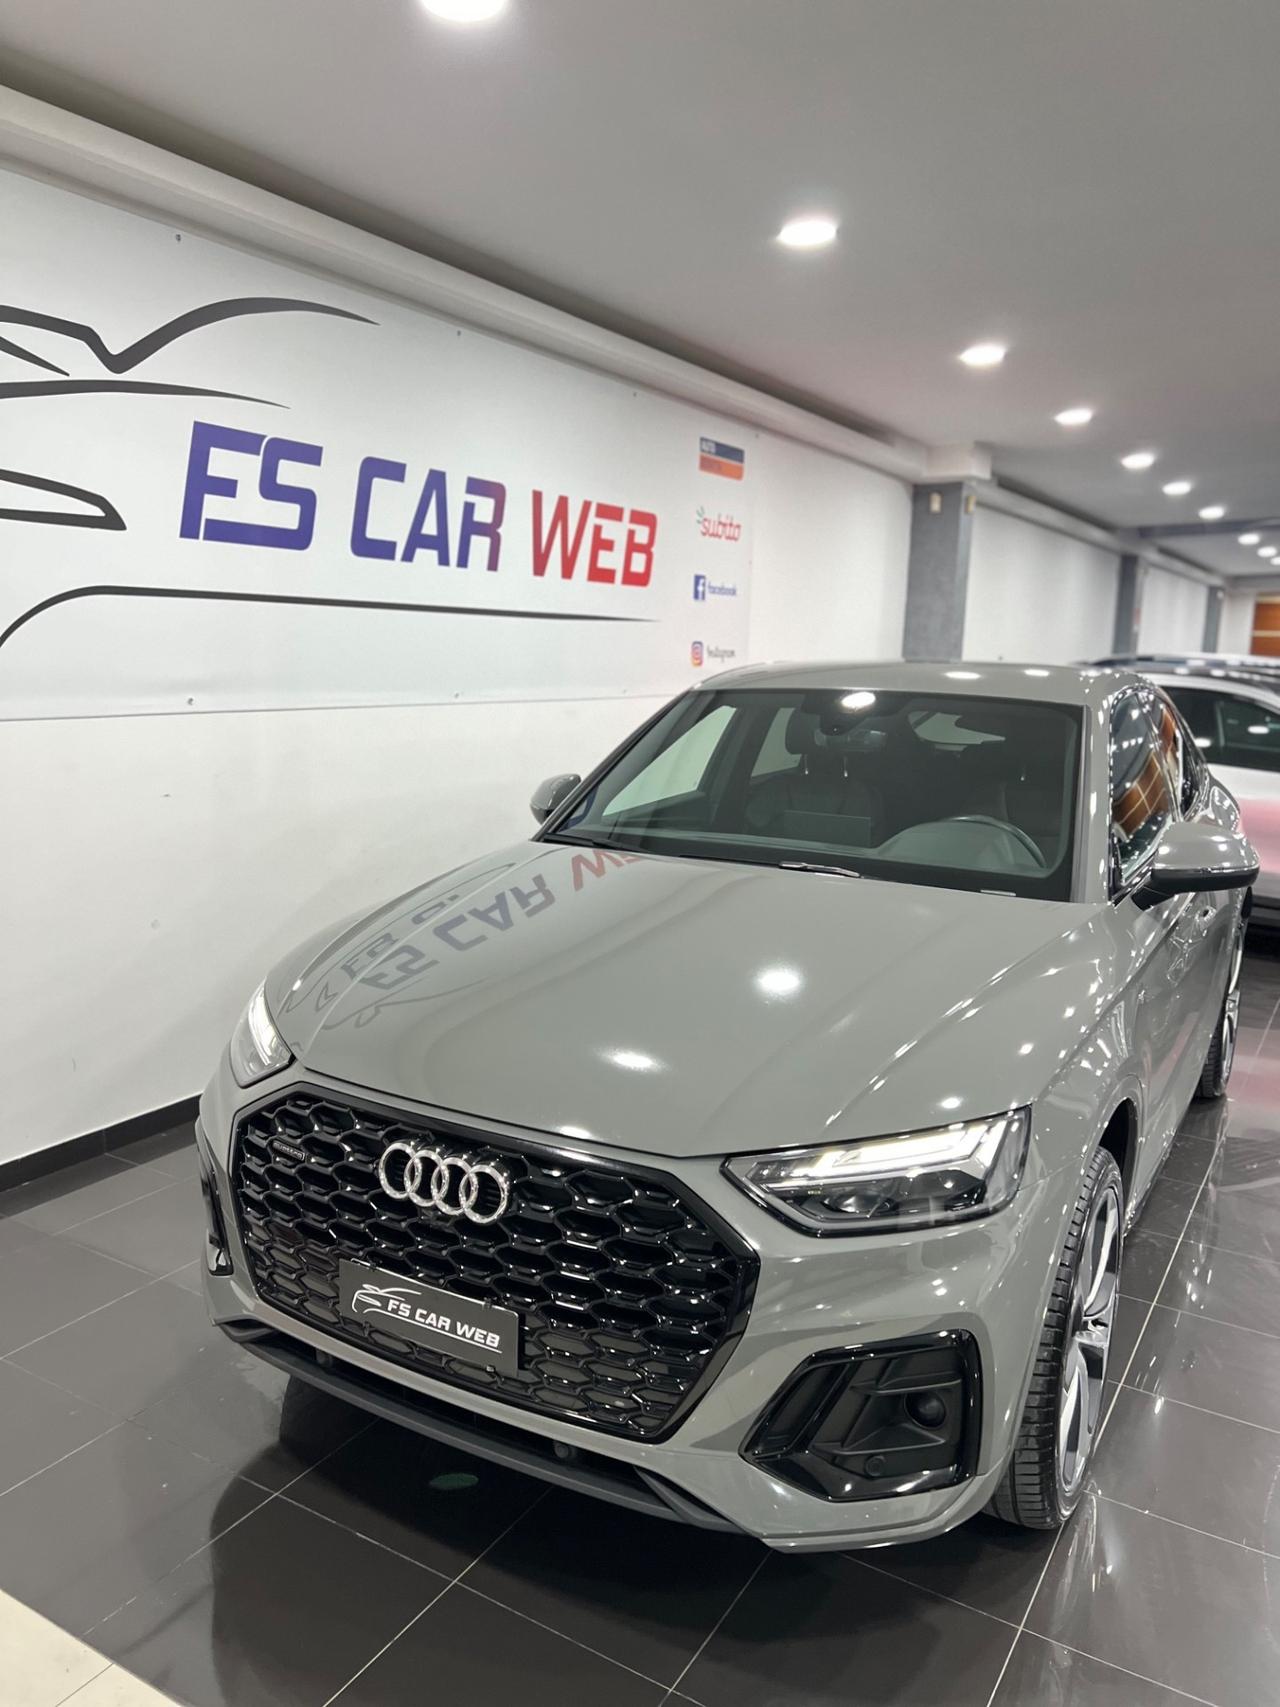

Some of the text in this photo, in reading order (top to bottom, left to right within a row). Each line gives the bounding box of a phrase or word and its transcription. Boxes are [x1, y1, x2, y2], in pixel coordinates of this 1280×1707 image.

[351, 457, 506, 571] CAR
[532, 490, 658, 588] WEB
[701, 512, 742, 541] subito
[708, 581, 737, 596] facebook
[387, 1299, 500, 1347] FS CAR WEB
